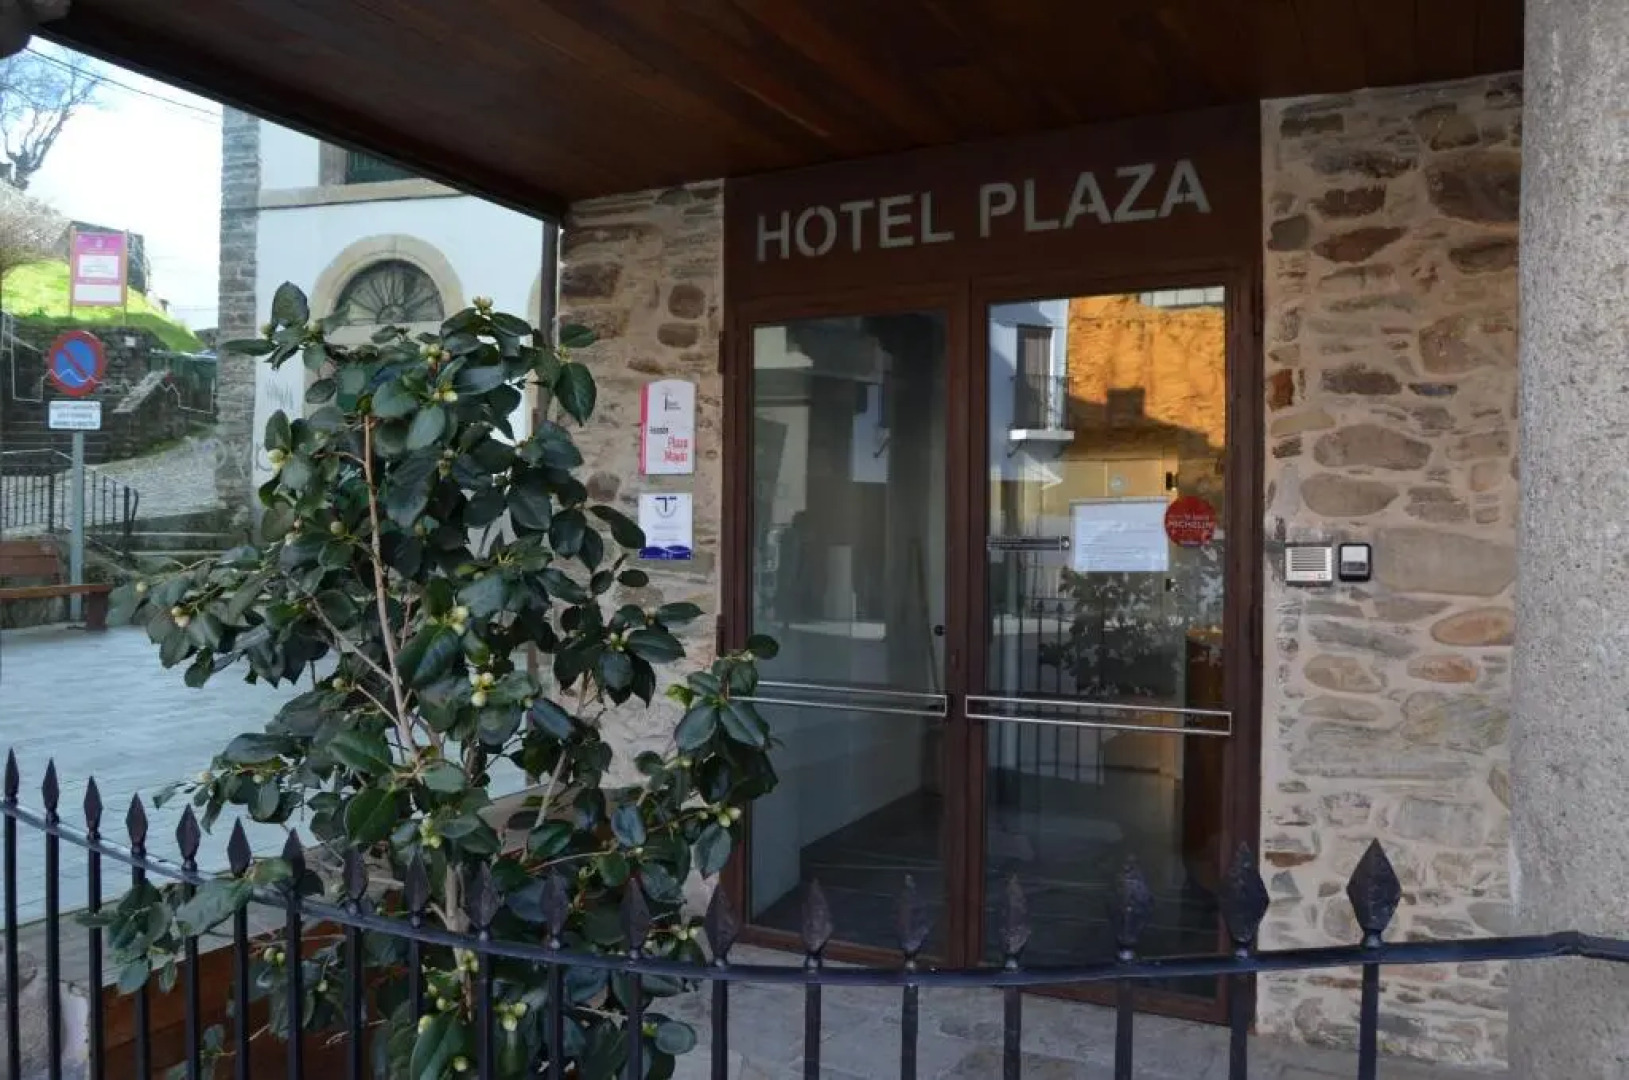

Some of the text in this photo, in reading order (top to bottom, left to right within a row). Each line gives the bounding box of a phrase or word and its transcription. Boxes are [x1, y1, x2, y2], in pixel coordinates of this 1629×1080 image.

[756, 159, 1212, 262] HOTEL PLAZA
[1168, 521, 1212, 529] MICHELIN
